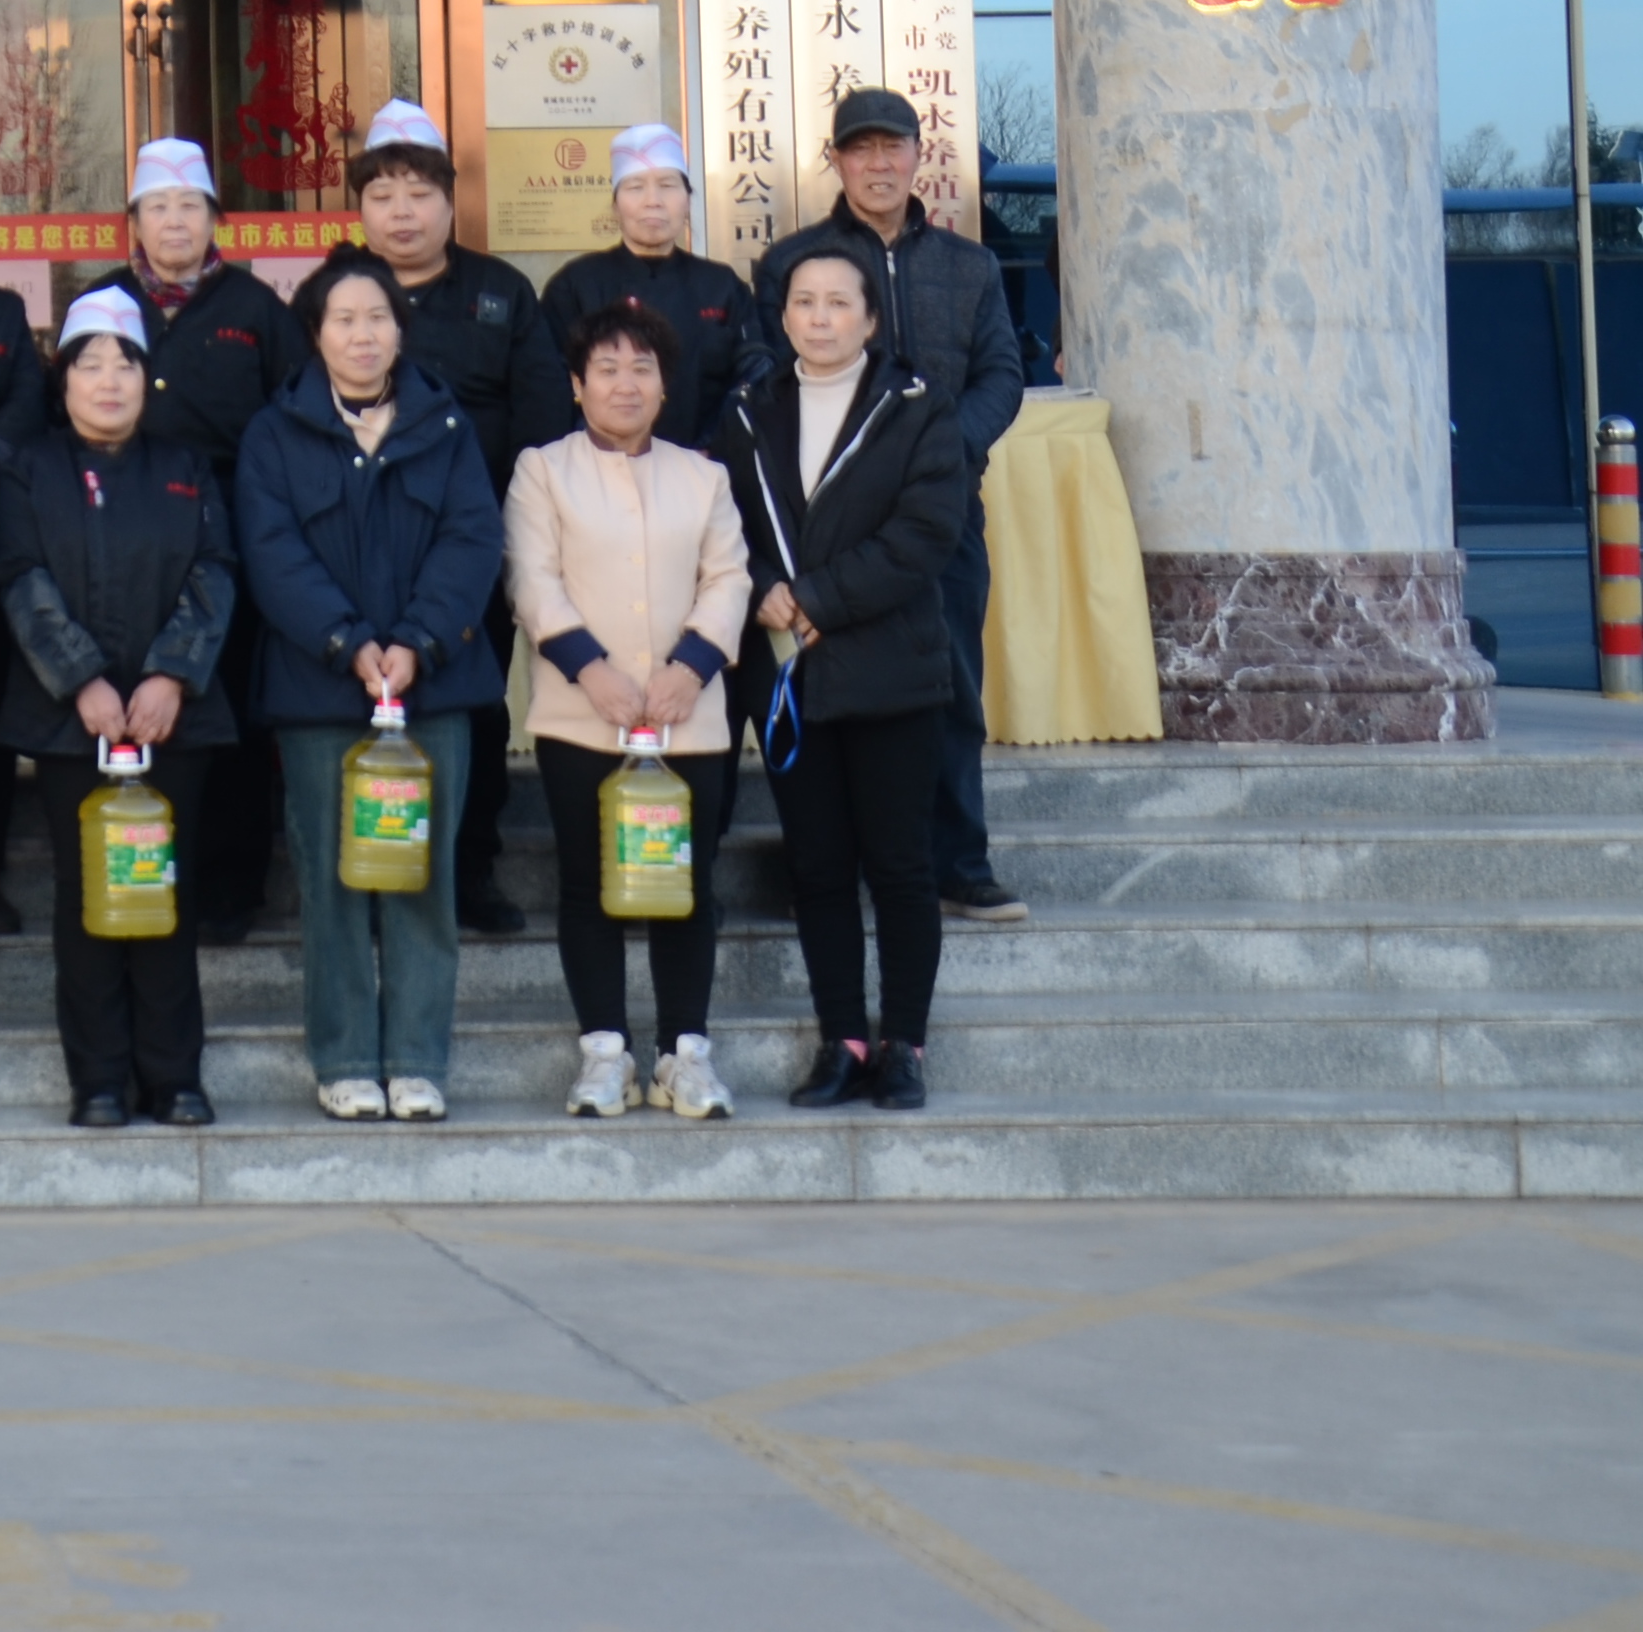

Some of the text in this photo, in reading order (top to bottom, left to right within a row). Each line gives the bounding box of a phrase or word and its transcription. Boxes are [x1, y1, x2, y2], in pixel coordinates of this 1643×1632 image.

[491, 18, 646, 71] 红十字救护培训基地
[524, 175, 558, 188] AAA
